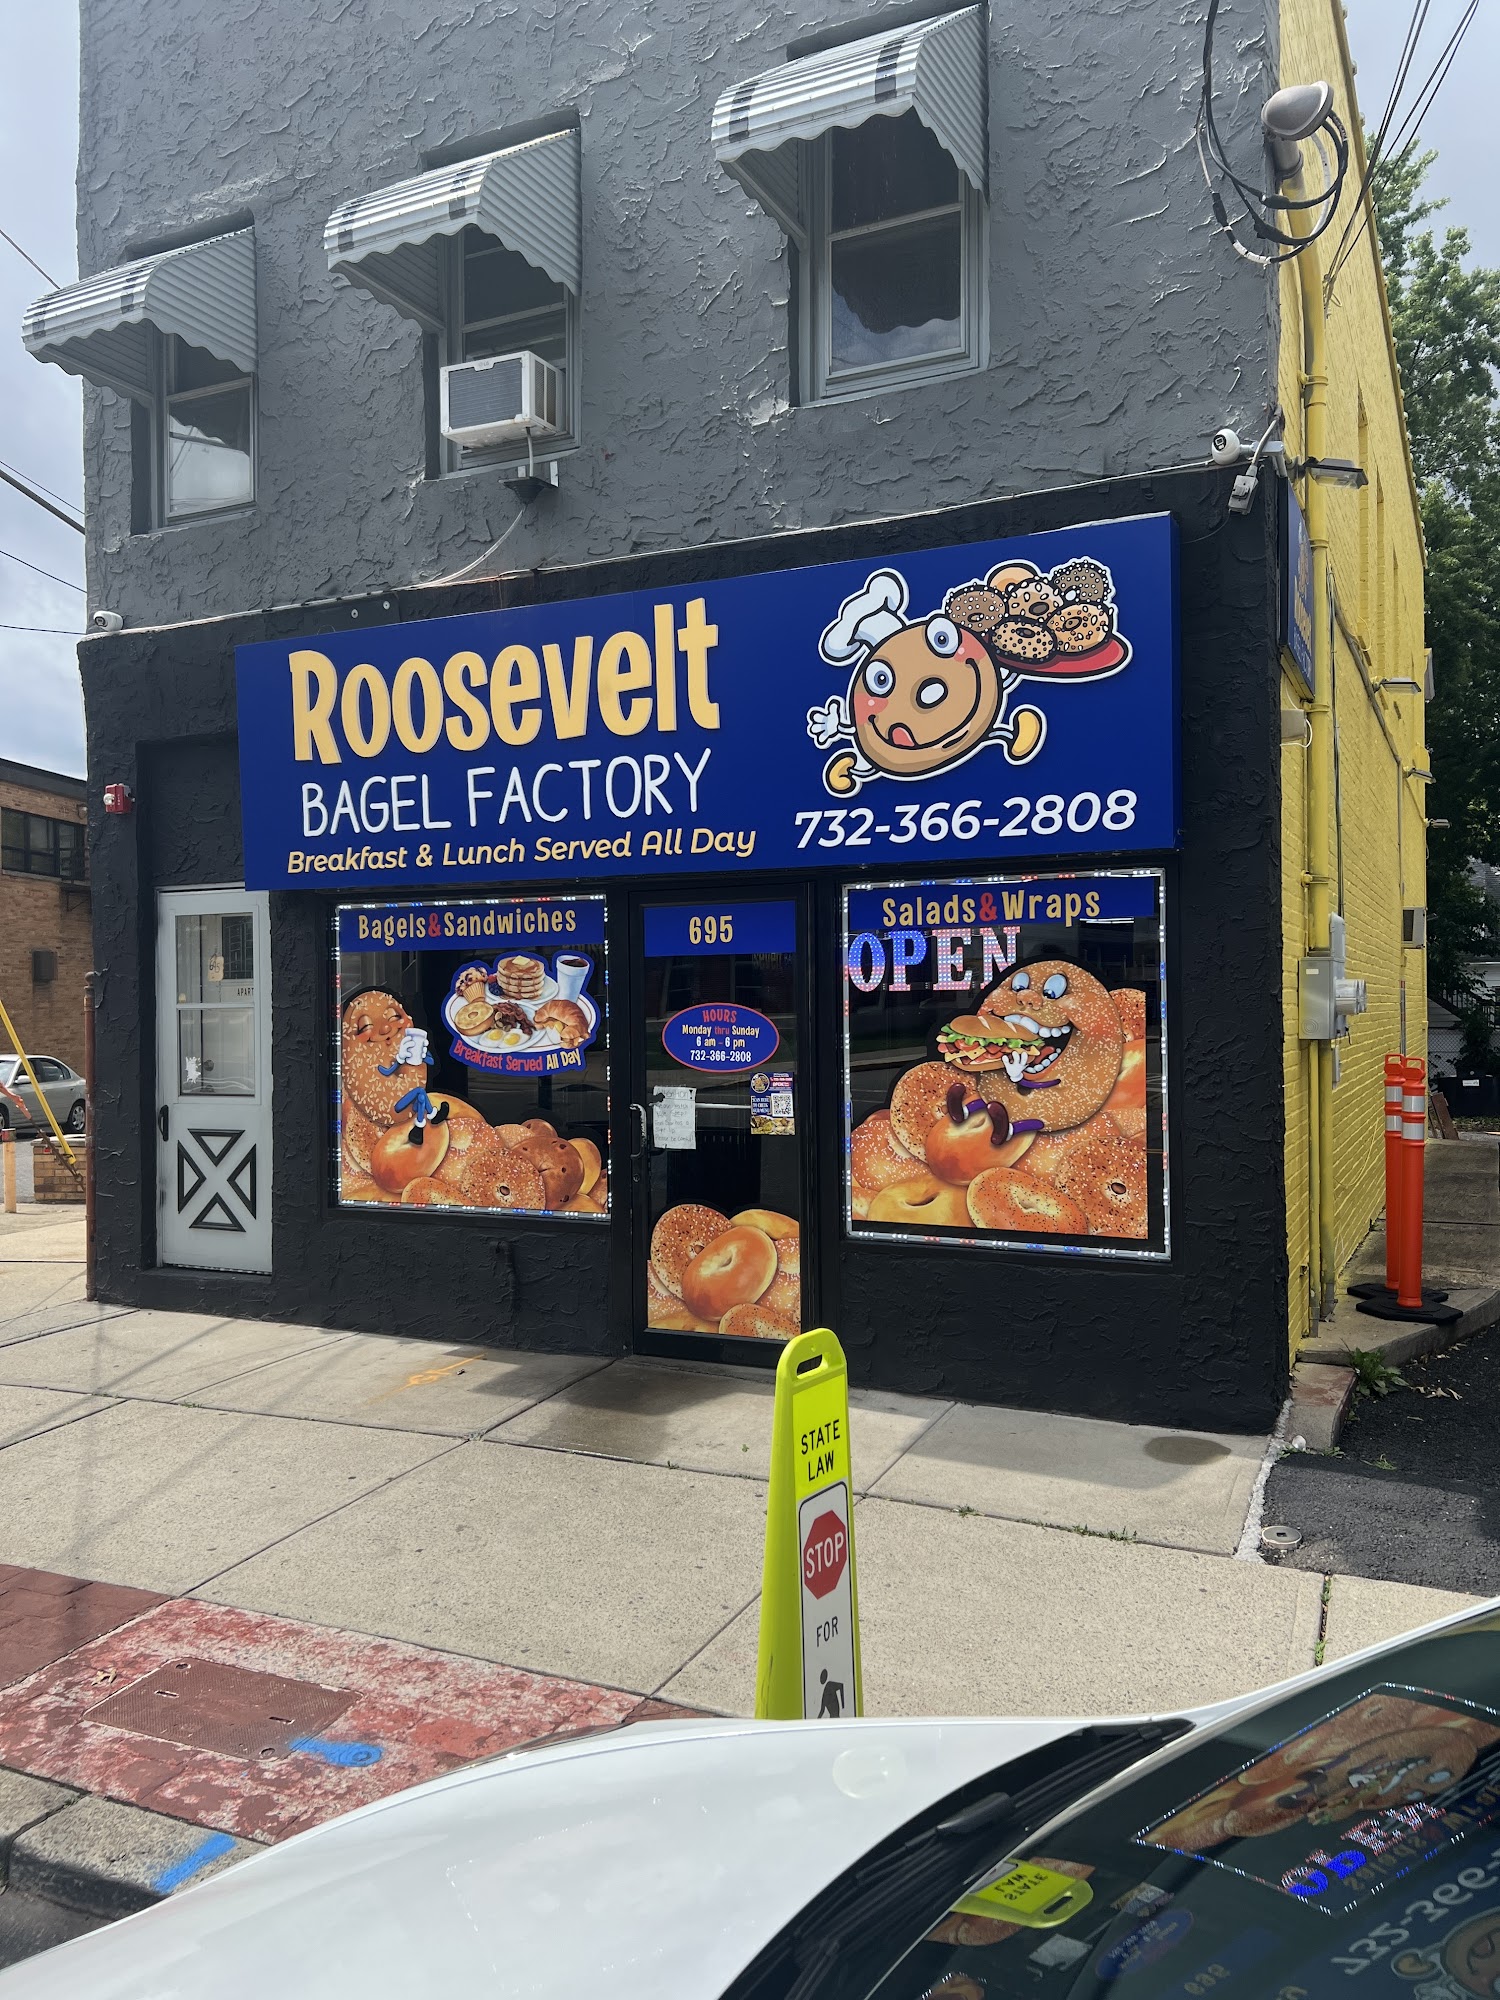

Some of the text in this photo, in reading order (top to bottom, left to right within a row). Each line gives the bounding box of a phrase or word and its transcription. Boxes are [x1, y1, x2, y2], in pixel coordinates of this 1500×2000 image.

[288, 597, 720, 765] Roosevelt
[301, 747, 712, 839] BAGEL FACTORY
[795, 789, 1138, 850] 732-366-2808
[287, 825, 756, 875] Breakfast & Lunch Served All Day
[688, 914, 735, 945] 695
[847, 925, 1021, 992] OPEN
[681, 1024, 760, 1039] Monday thru Sunday
[701, 1008, 738, 1024] HOURS
[453, 1039, 582, 1072] Breakfast Served All Day
[689, 1049, 752, 1063] 732-366-2808
[696, 1036, 702, 1047] 6
[704, 1038, 716, 1047] am
[725, 1036, 731, 1048] 6
[733, 1038, 746, 1050] pm
[801, 1418, 841, 1456] STATE
[808, 1450, 835, 1482] LAW
[806, 1531, 844, 1580] STOP
[815, 1615, 839, 1649] FOR
